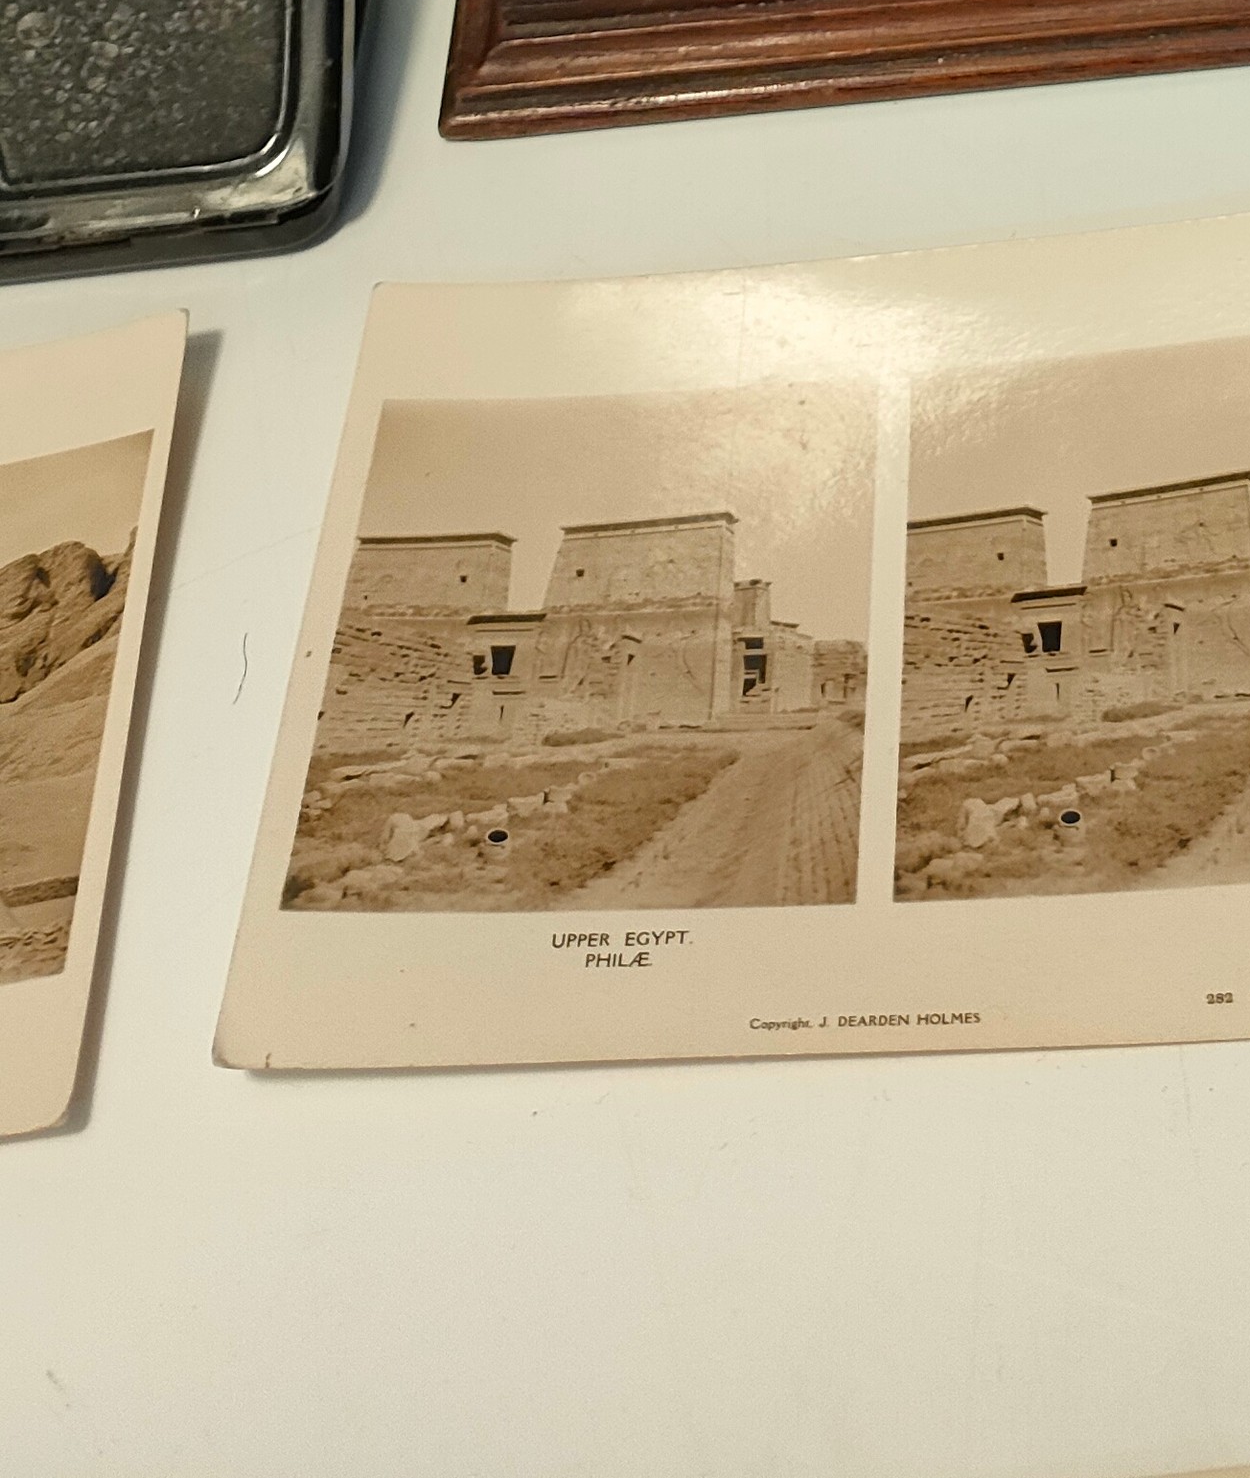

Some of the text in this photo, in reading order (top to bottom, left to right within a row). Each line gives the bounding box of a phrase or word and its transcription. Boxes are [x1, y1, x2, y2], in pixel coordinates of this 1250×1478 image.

[552, 932, 610, 948] UPPER
[1206, 992, 1234, 1005] 282
[837, 1013, 910, 1028] DEARDEN
[916, 1012, 981, 1026] HOLMES
